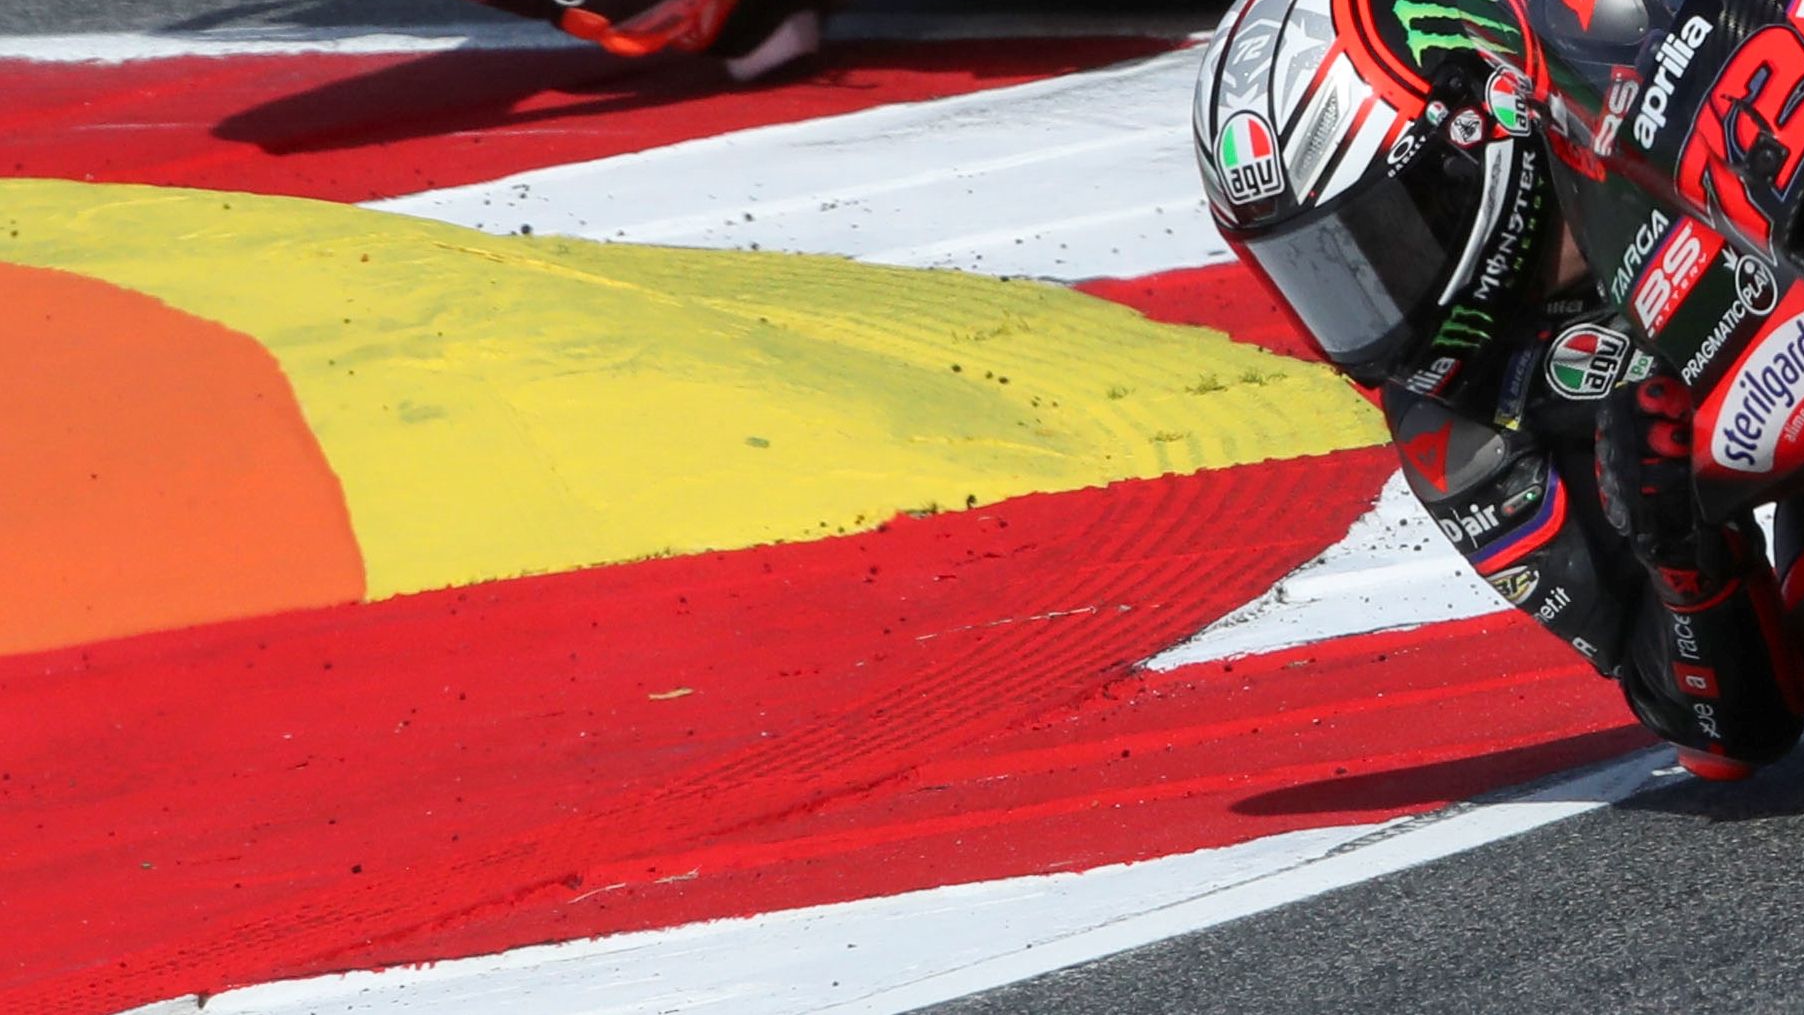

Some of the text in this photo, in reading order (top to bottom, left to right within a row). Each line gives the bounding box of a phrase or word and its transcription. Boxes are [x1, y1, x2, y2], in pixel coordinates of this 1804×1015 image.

[1633, 15, 1713, 149] aprilia
[1230, 160, 1274, 200] agv
[1475, 150, 1537, 302] MONSTER
[1611, 210, 1669, 305] TARGA
[1635, 232, 1704, 329] BS
[1647, 253, 1709, 338] BATTERY
[1582, 333, 1622, 392] agv
[1681, 271, 1772, 385] PRAGMATIC PLAY
